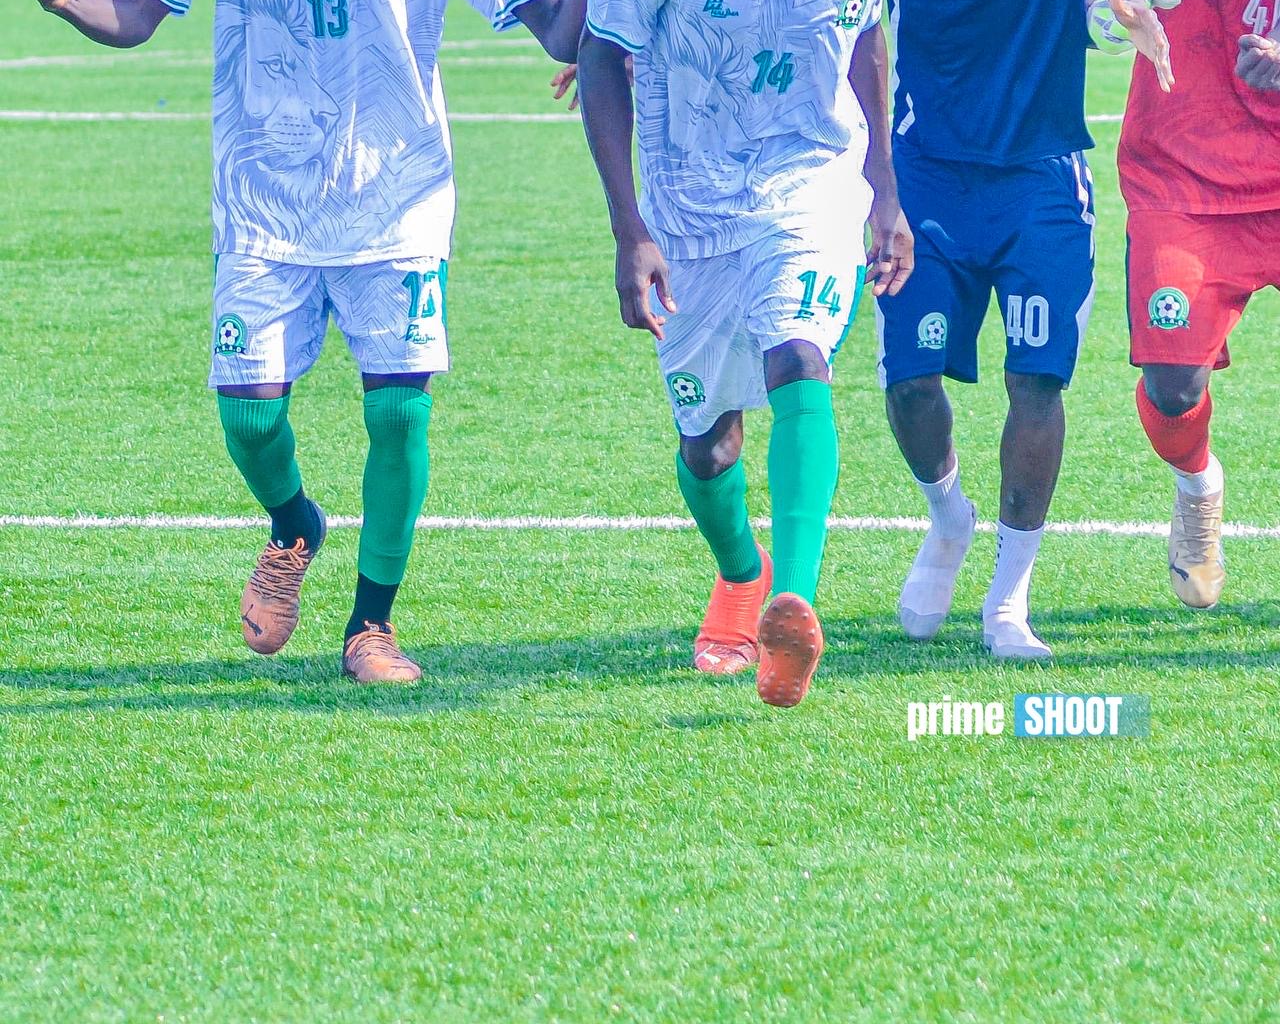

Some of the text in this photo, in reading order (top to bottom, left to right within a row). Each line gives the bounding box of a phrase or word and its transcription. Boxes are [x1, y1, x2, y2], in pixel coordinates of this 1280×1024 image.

[752, 50, 794, 94] 14
[794, 270, 841, 319] 14
[1006, 294, 1049, 347] 40
